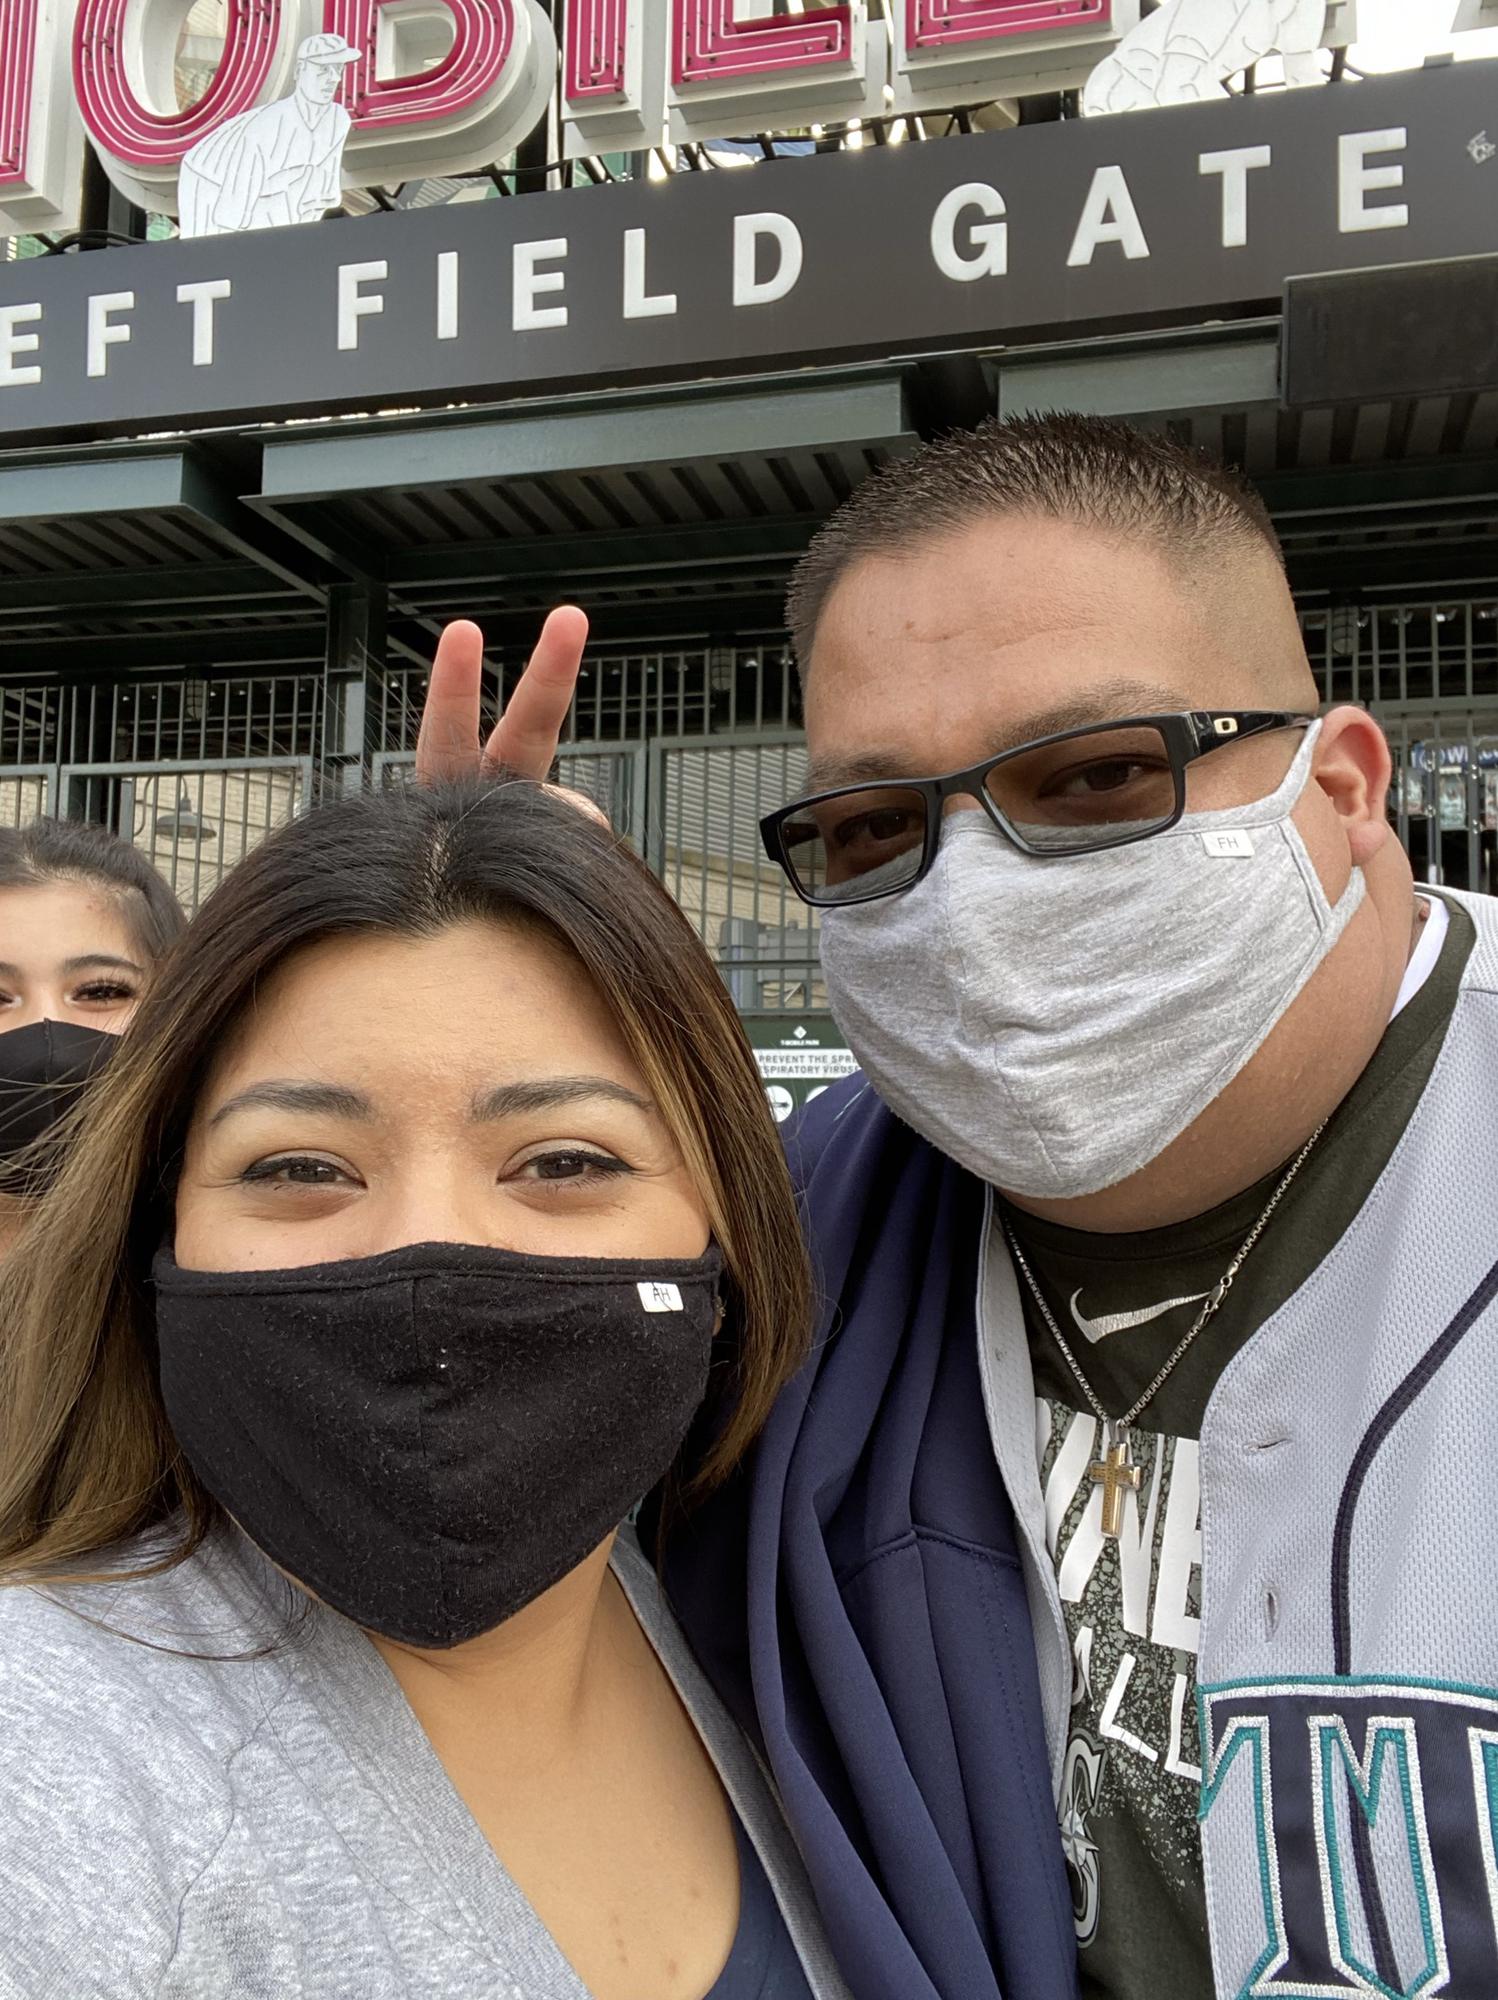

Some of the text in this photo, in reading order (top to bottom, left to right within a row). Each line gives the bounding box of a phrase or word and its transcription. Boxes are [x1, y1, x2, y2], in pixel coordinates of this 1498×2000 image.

[337, 213, 804, 351] FIELD
[931, 127, 1409, 282] GATE
[1217, 837, 1239, 849] FH
[759, 1055, 805, 1064] PREVENT
[809, 1055, 828, 1064] THE
[761, 1066, 819, 1074] SPIRATORY
